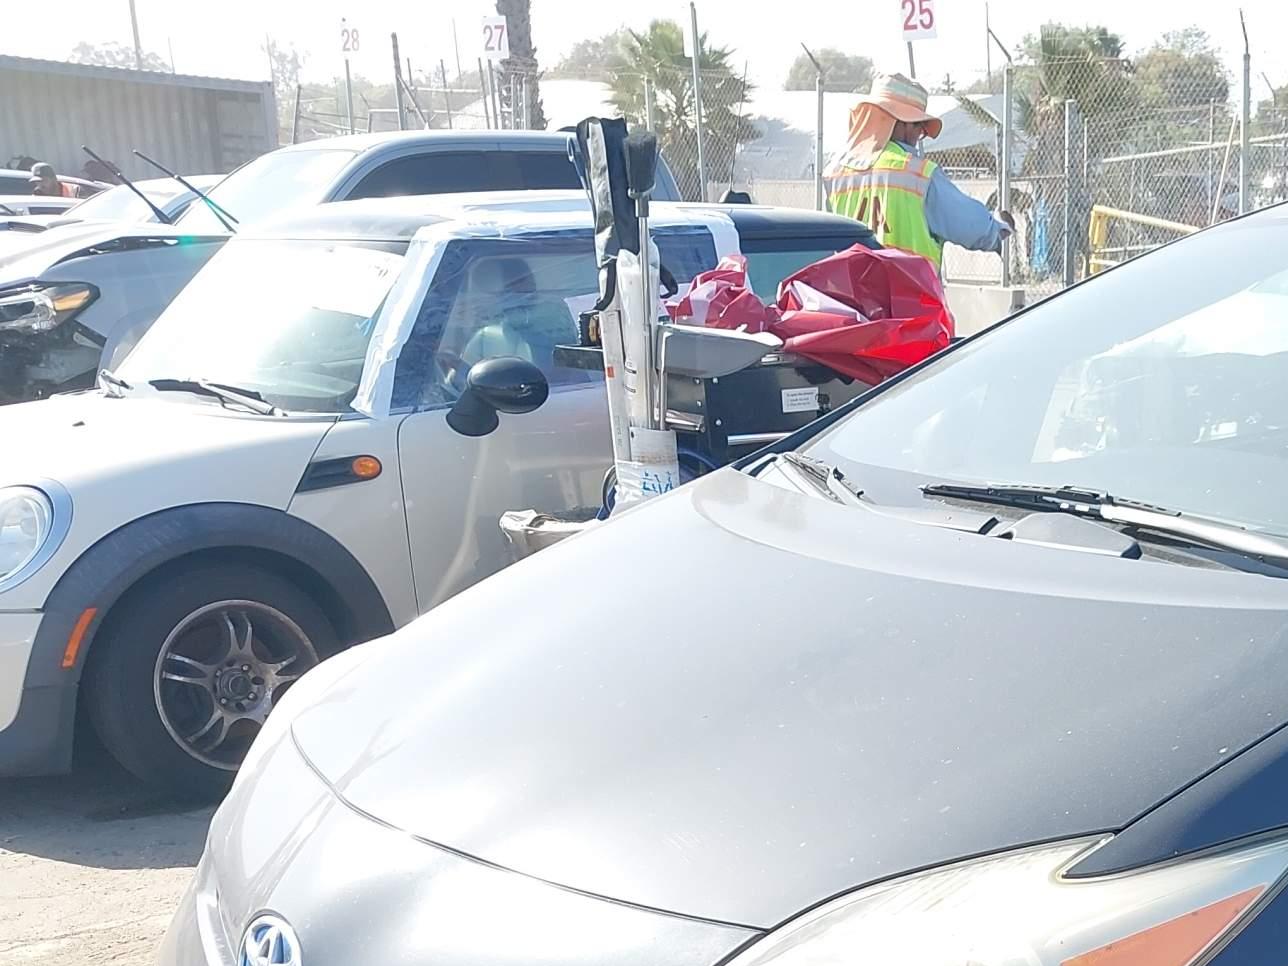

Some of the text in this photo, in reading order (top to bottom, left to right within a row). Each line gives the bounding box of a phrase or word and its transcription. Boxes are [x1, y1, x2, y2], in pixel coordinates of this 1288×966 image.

[901, 0, 934, 30] 25
[341, 28, 360, 51] 28
[483, 24, 505, 51] 27
